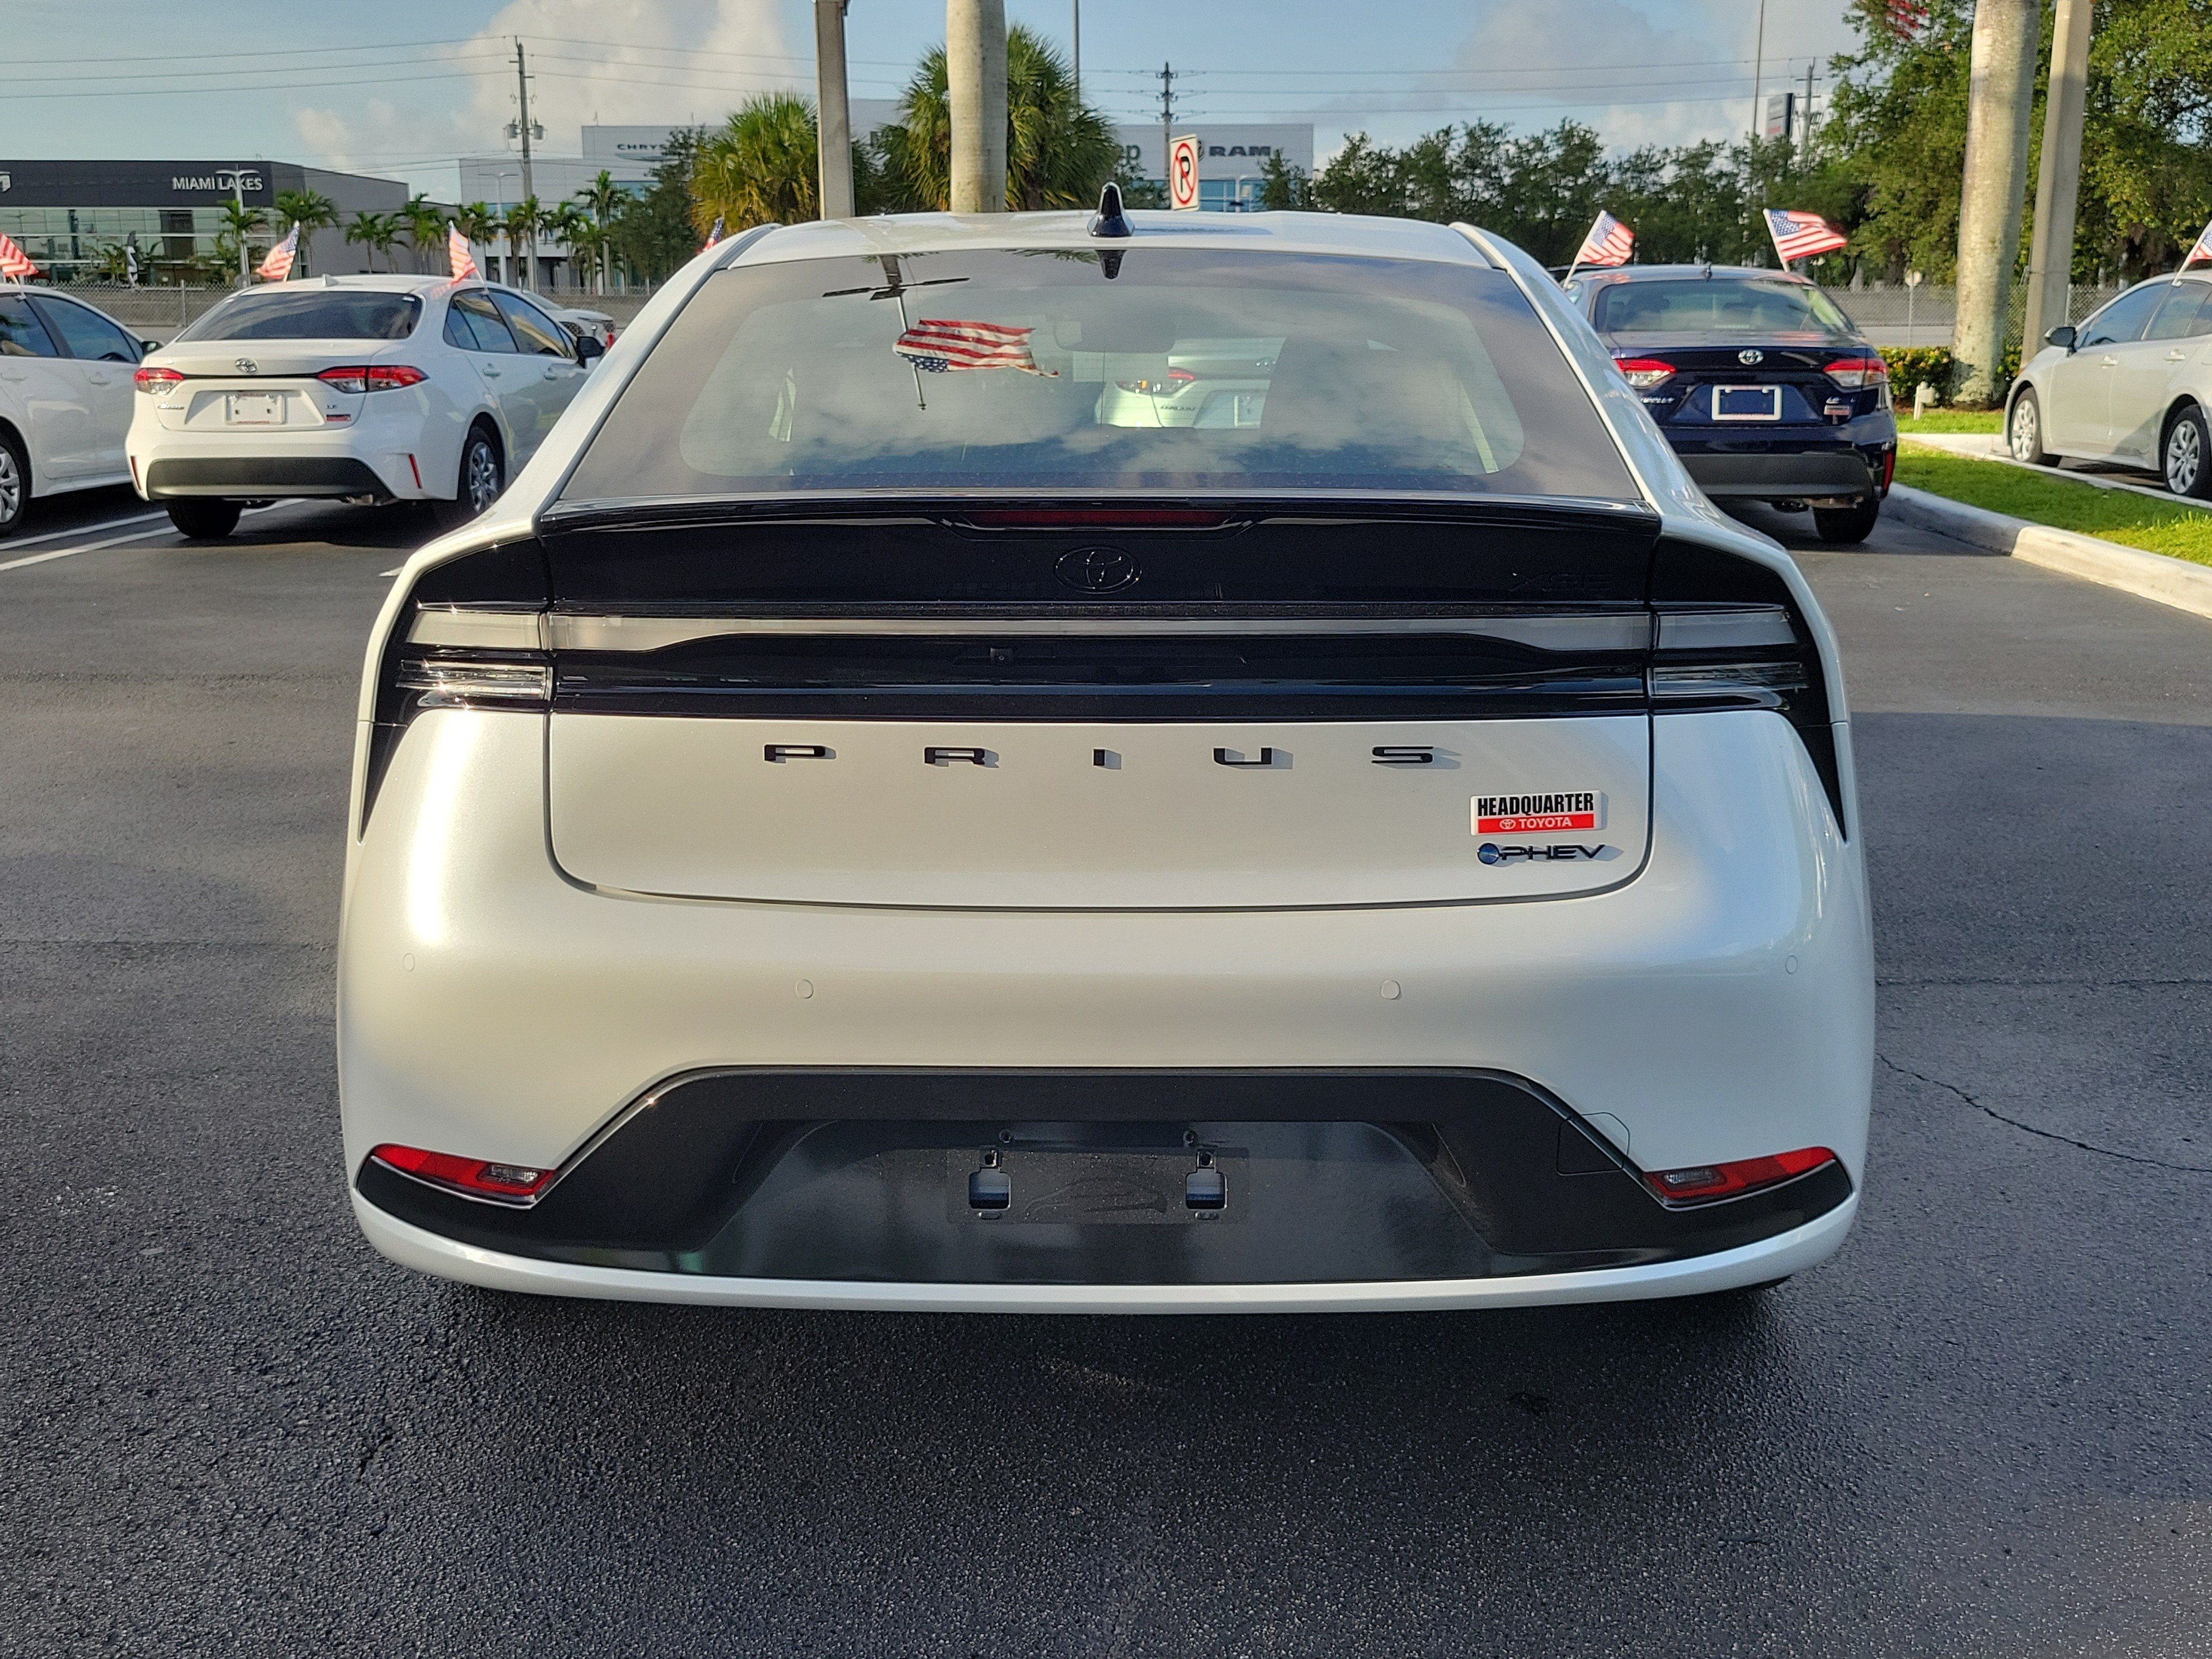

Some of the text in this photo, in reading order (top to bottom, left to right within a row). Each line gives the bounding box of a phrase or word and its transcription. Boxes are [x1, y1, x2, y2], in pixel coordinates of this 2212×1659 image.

[1209, 146, 1271, 156] RAM
[172, 176, 263, 191] MIAMI LAKES
[764, 744, 1434, 765] PRIUS
[1477, 792, 1594, 816] HEADQUARTER
[1518, 816, 1573, 829] TOYOTA
[1499, 844, 1606, 860] PHEV
